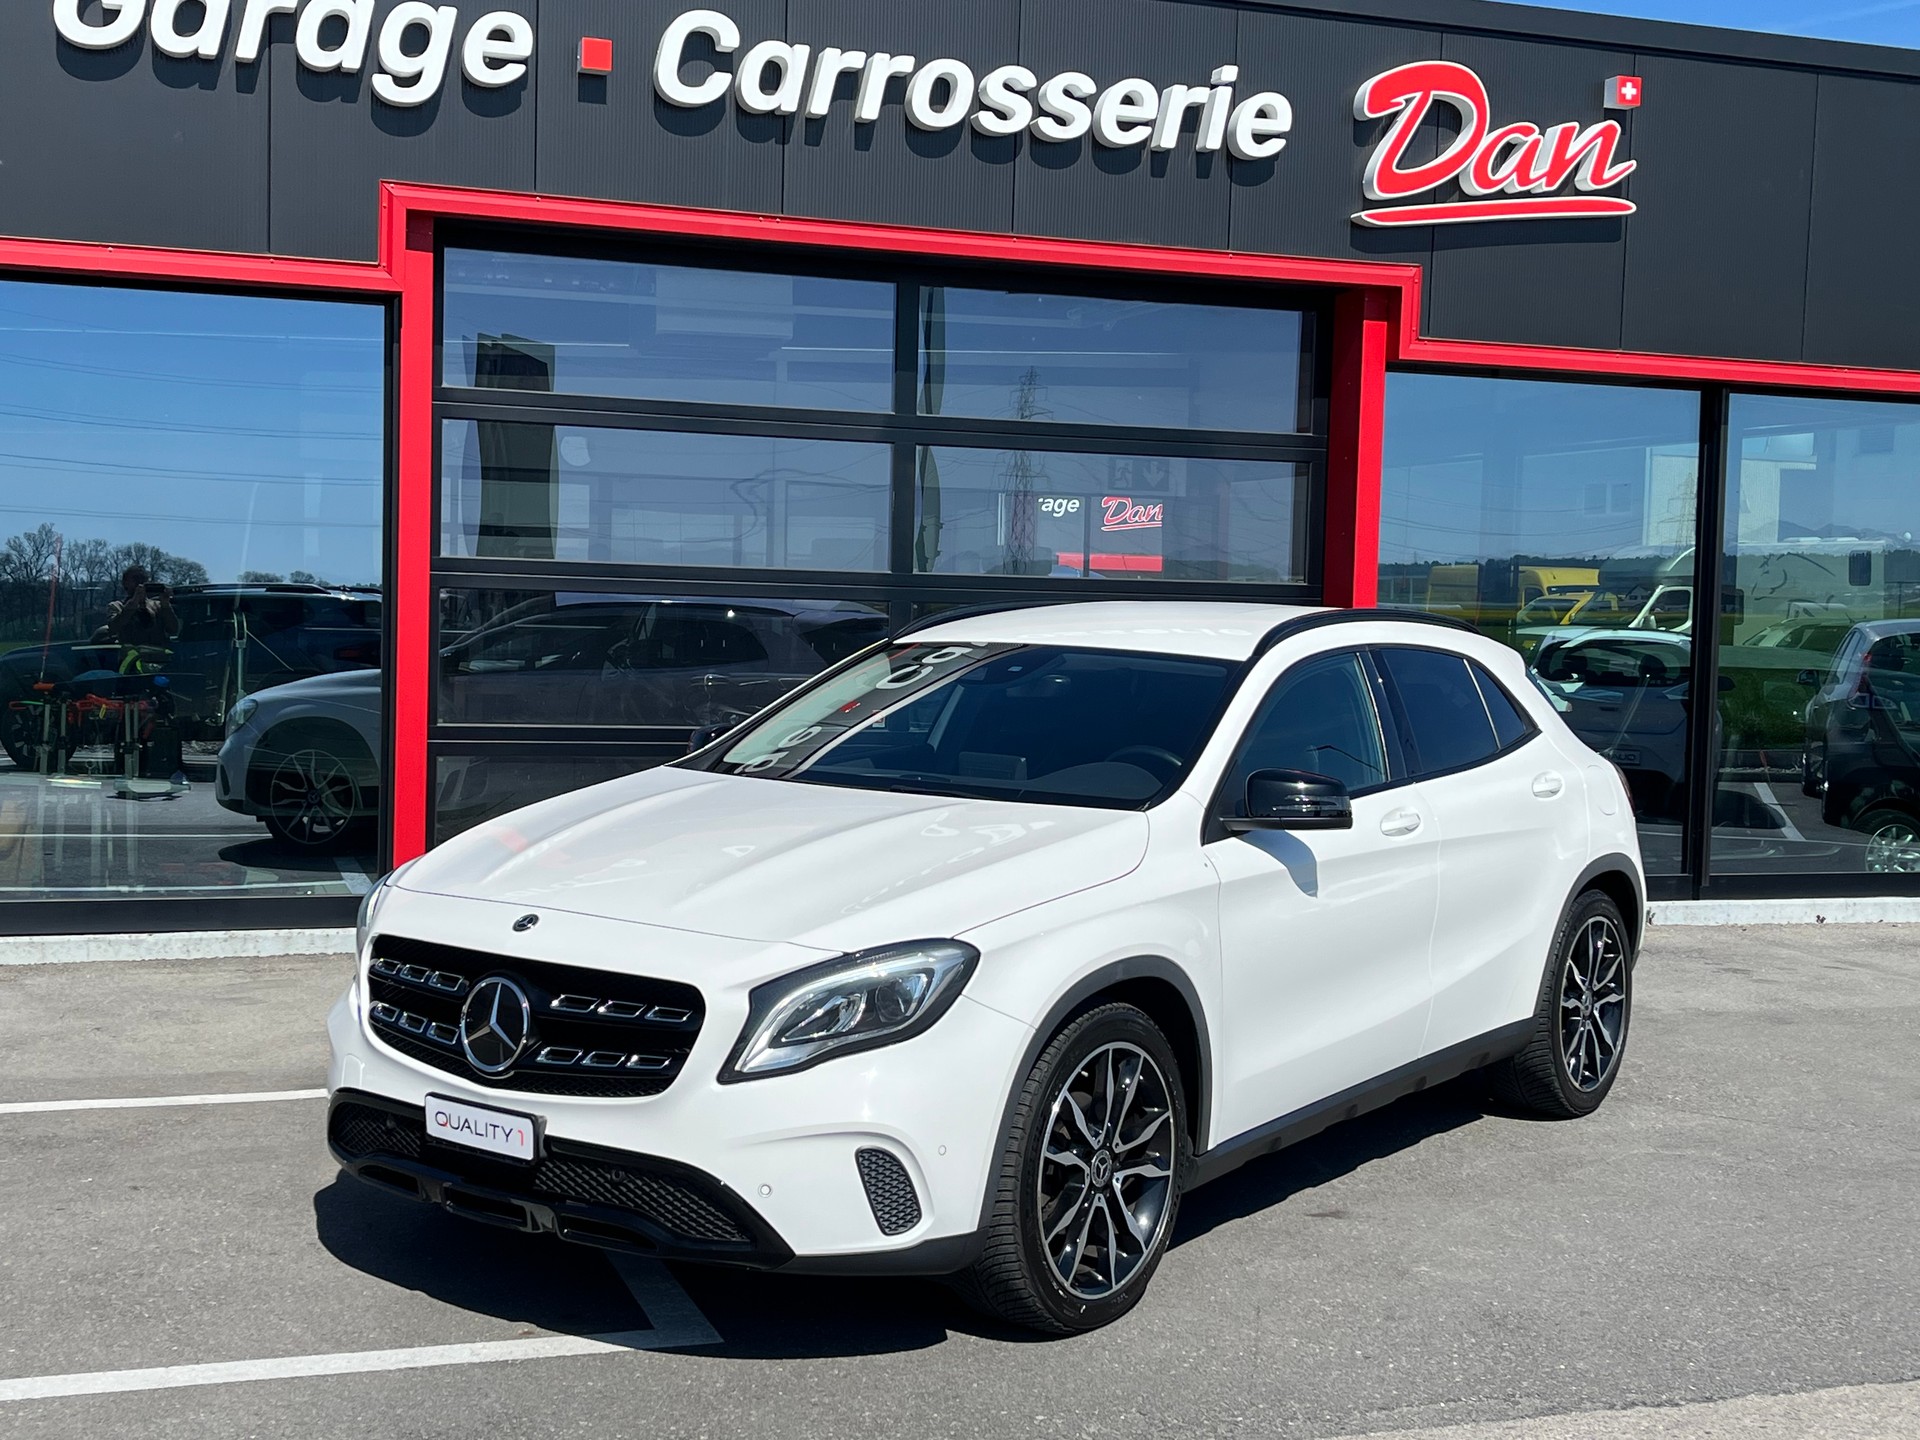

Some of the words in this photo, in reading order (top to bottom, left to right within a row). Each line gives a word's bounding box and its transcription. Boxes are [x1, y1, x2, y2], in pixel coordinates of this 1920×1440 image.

[653, 9, 1293, 160] Carrosserie
[1353, 60, 1637, 200] Dan
[1038, 498, 1080, 517] age
[1101, 496, 1163, 525] Dan
